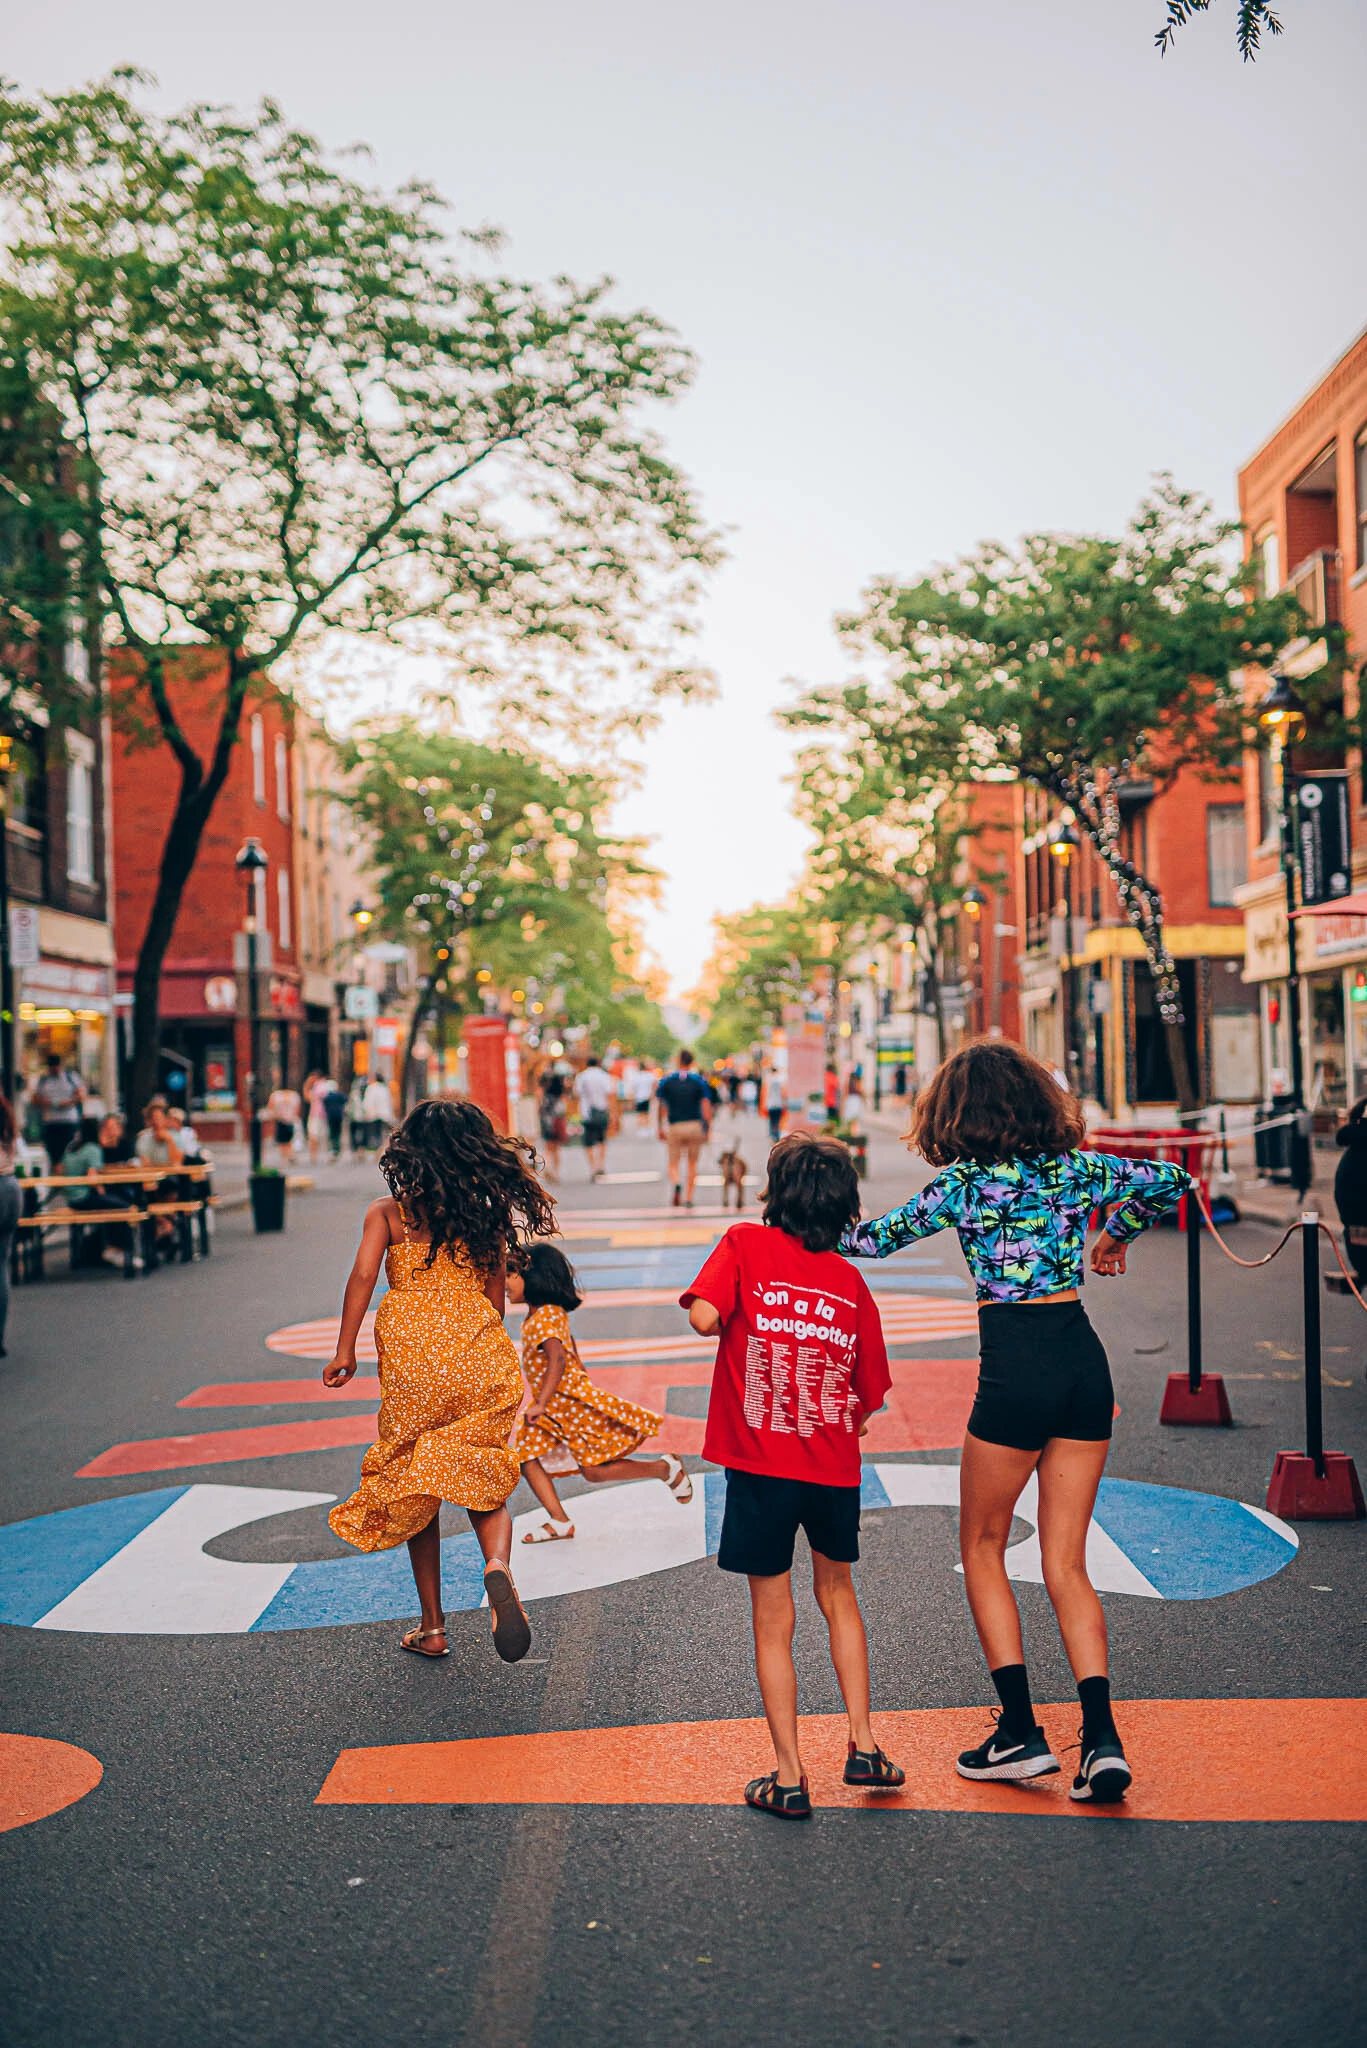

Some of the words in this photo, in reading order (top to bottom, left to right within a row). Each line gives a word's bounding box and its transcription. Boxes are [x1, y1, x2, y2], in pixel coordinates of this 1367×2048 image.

[763, 1291, 789, 1306] on
[794, 1300, 809, 1315] a
[814, 1298, 836, 1322] la
[756, 1314, 857, 1350] bougeotte!
